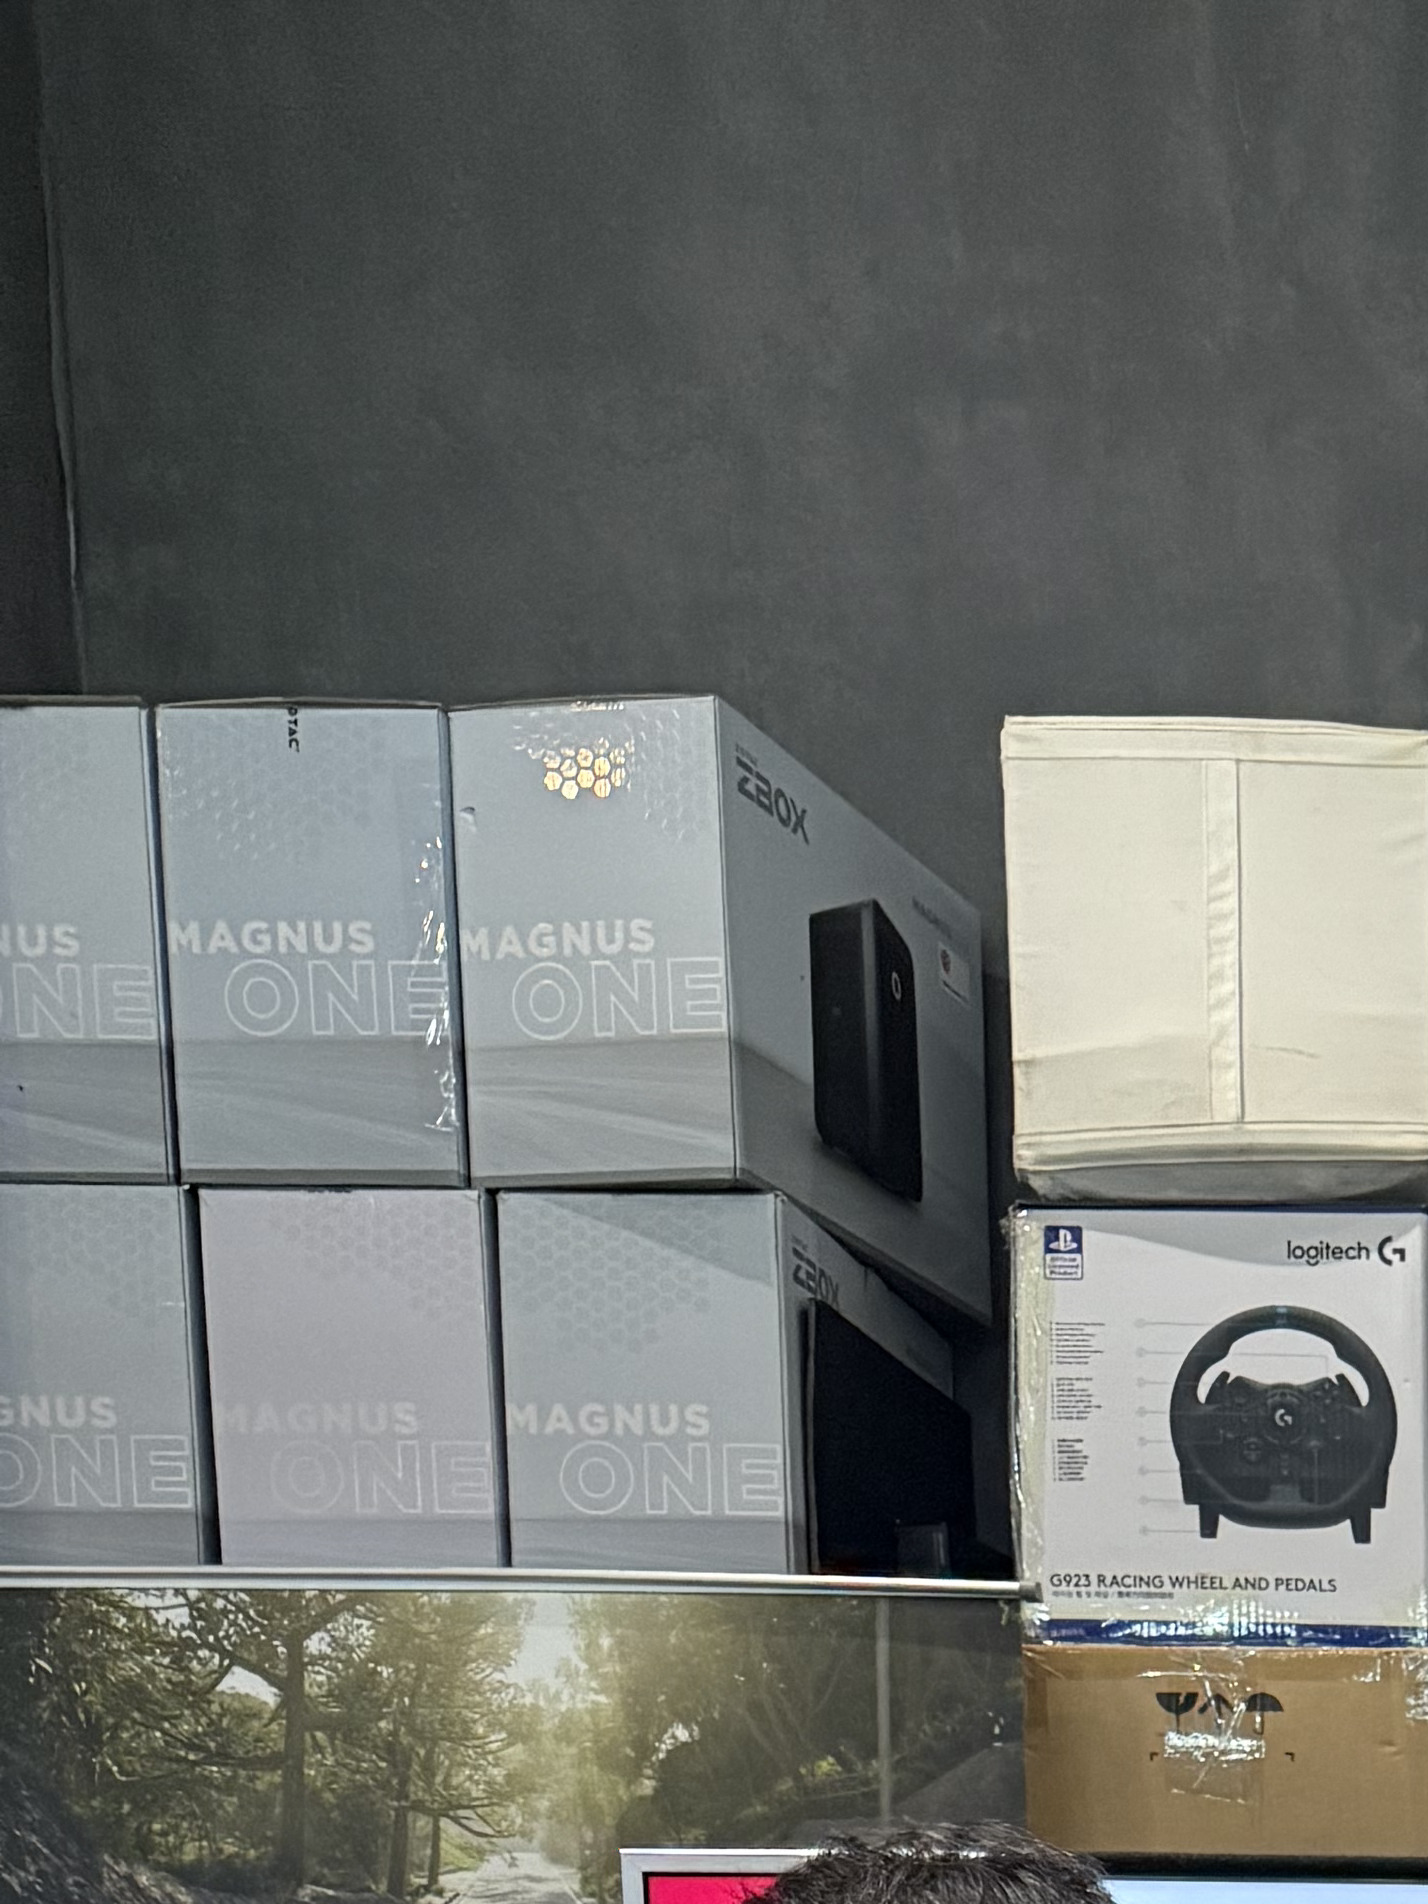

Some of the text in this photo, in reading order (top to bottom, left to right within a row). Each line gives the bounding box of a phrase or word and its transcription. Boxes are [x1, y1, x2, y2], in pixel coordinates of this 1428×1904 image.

[287, 706, 300, 753] OTAC
[171, 919, 375, 956] MAGNUS
[460, 918, 656, 961] MAGNUS
[10, 962, 156, 1039] NE
[223, 958, 448, 1037] ONE
[512, 956, 728, 1041] ONE
[1287, 1239, 1370, 1267] logitech
[507, 1402, 711, 1437] MAGNUS
[270, 1440, 494, 1515] ONE
[559, 1439, 786, 1517] ONE
[1050, 1573, 1338, 1593] G923 RACING WHEEL AND PEDALS
